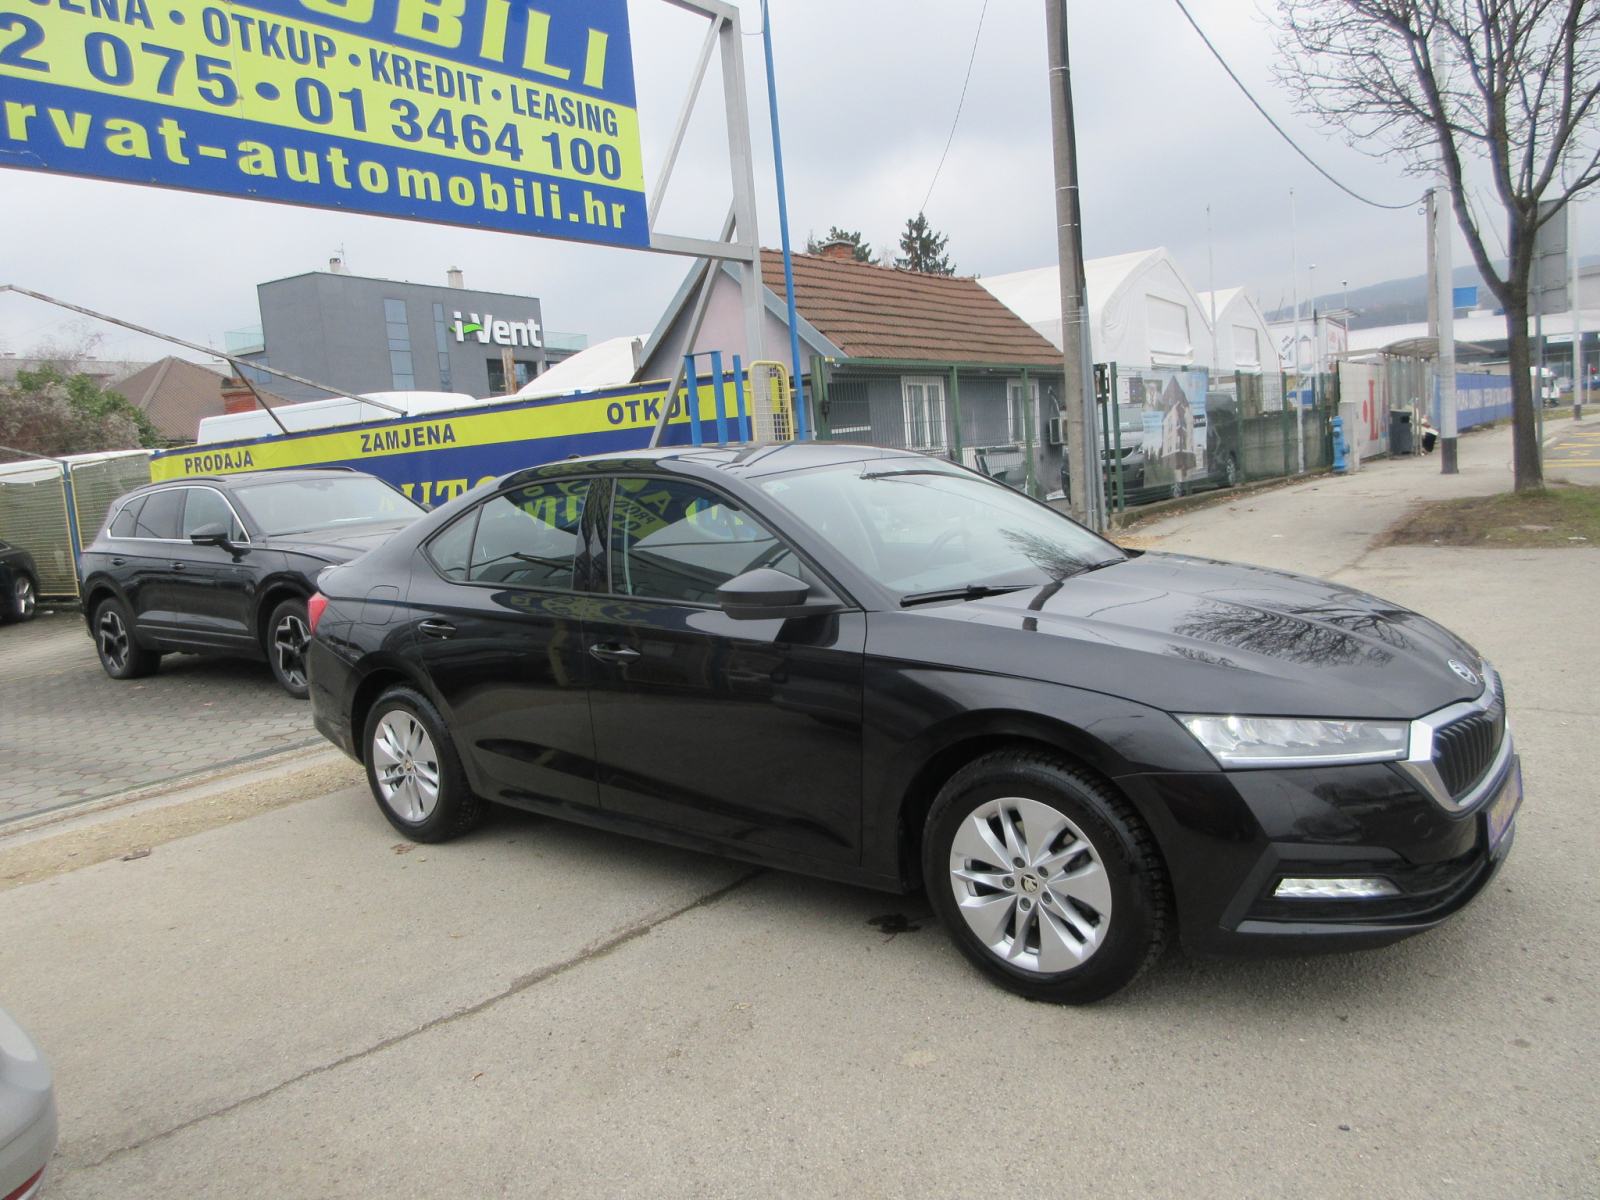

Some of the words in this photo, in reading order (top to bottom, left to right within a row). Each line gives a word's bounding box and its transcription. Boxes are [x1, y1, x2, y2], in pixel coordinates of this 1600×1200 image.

[84, 31, 238, 107] 075
[295, 77, 367, 132] 01
[389, 98, 523, 162] 3464
[541, 132, 622, 181] 100
[203, 6, 337, 69] OTKUP
[369, 47, 483, 106] KREDIT
[510, 84, 618, 137] LEASING
[4, 99, 626, 229] rvat-automobili.hr
[184, 450, 254, 474] PRODAJA
[361, 422, 456, 453] ZAMJENA
